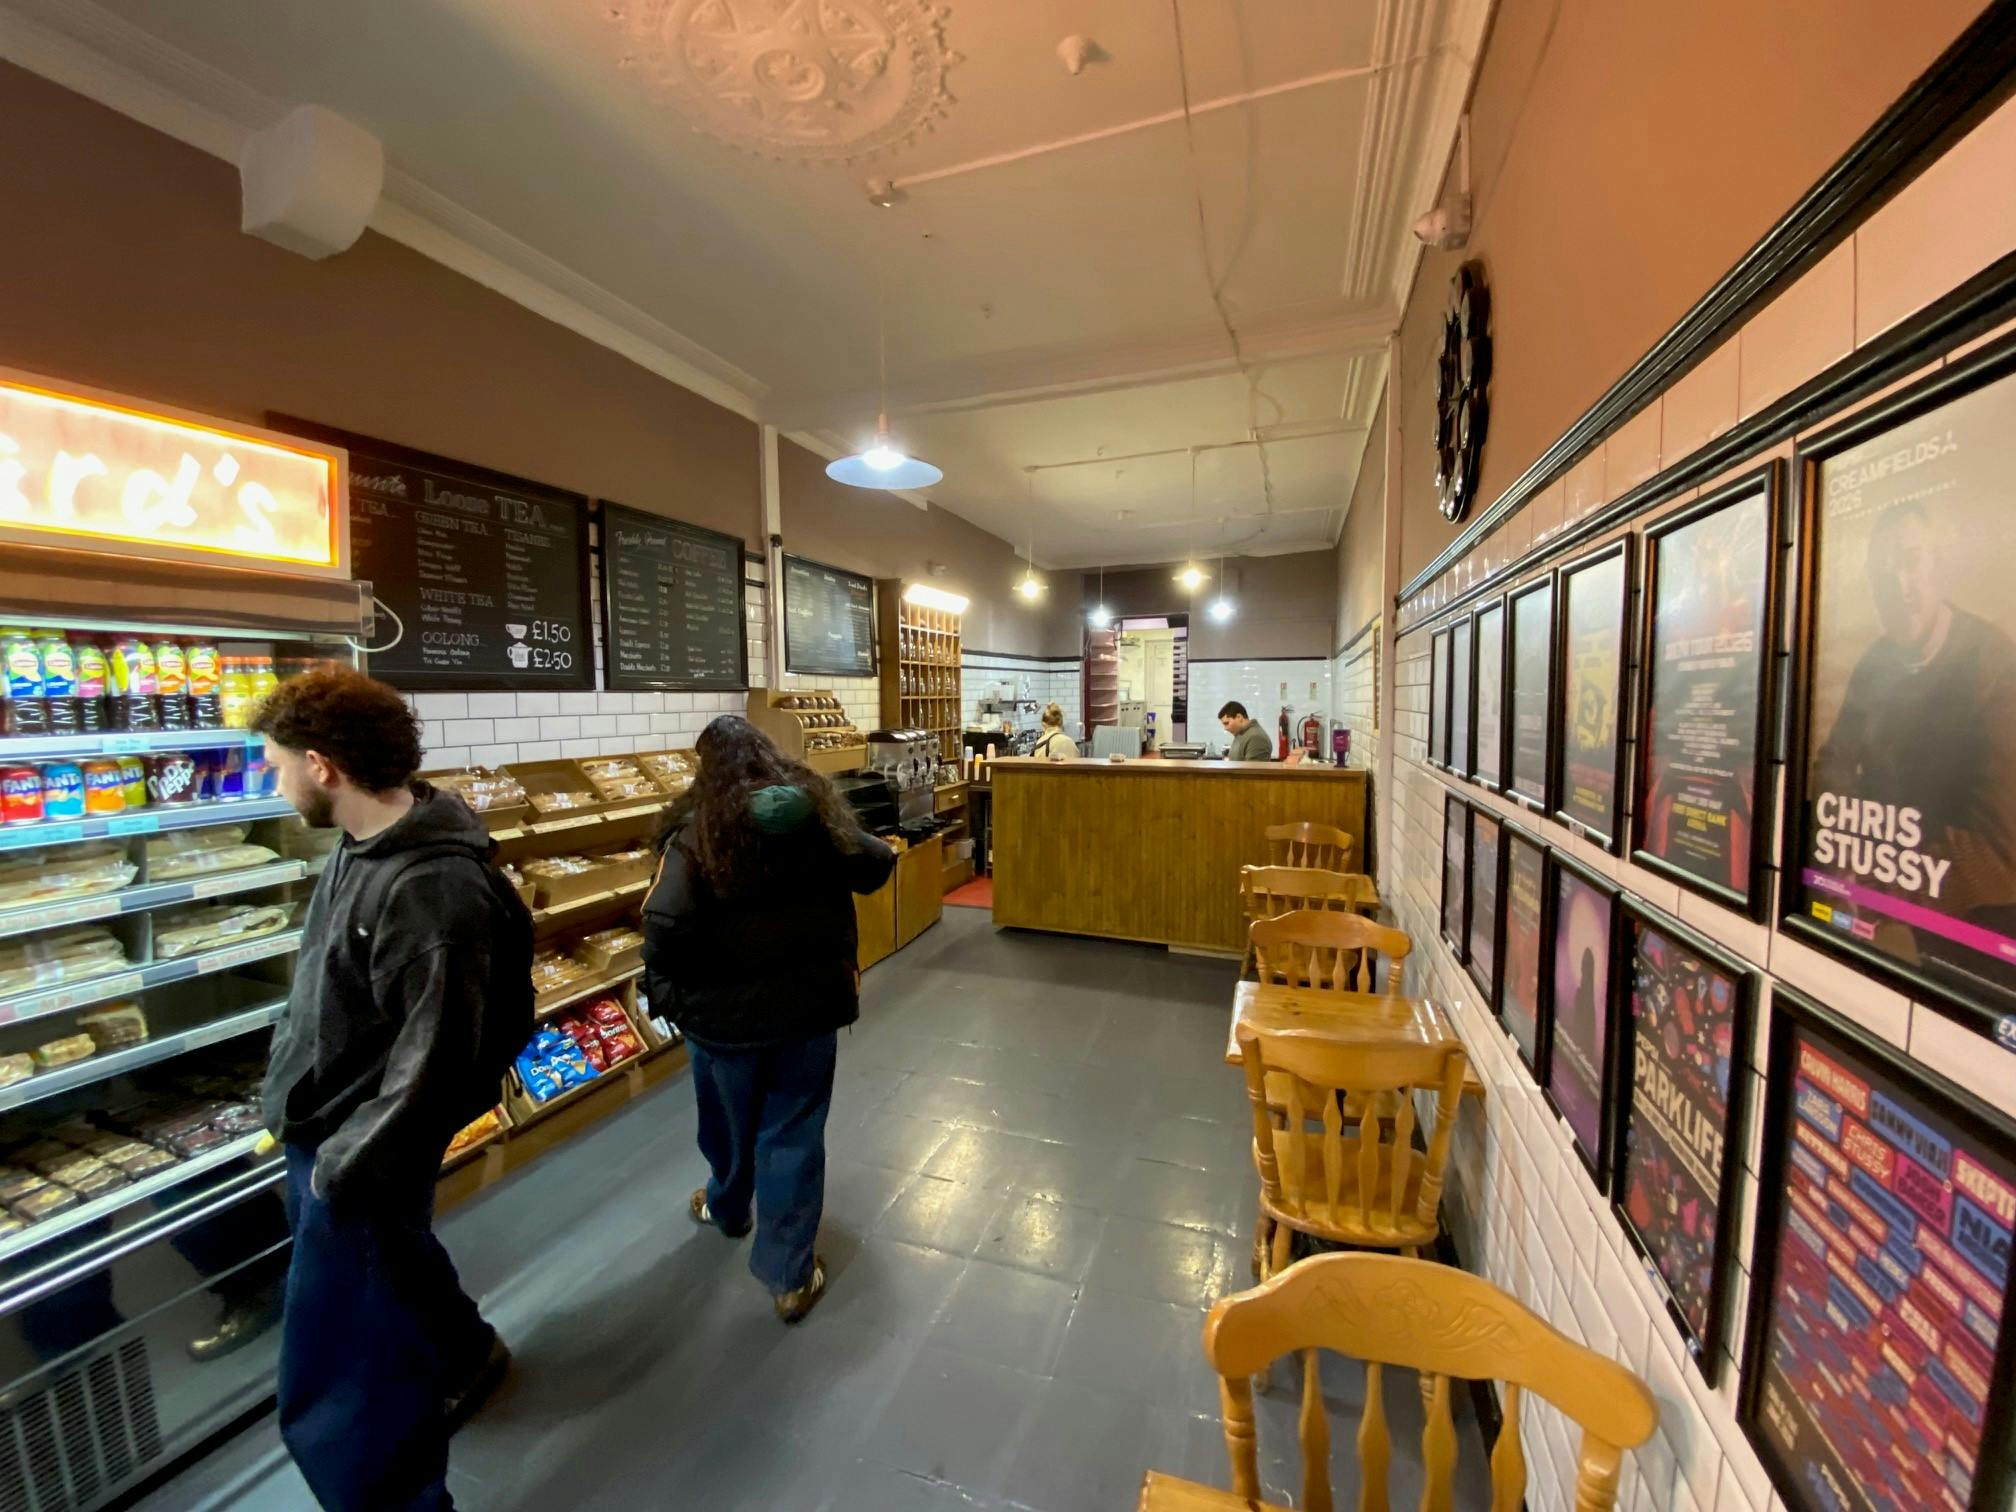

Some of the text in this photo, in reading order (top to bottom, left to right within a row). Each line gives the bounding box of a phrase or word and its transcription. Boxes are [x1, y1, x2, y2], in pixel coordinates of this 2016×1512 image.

[494, 495, 547, 528] TEA
[419, 587, 495, 607] WHITE TEA
[422, 631, 480, 647] OOLONG
[532, 620, 571, 643] £1.50
[533, 648, 572, 670] £2.50
[2, 776, 41, 799] FANT
[84, 768, 122, 790] FANT
[1816, 792, 1922, 848] CHRIS
[1814, 828, 1951, 898] STUSSY
[1635, 1047, 1724, 1178] PARKLIFE
[1849, 1124, 1887, 1161] CHRIS
[1843, 1137, 1890, 1180] STUSSY
